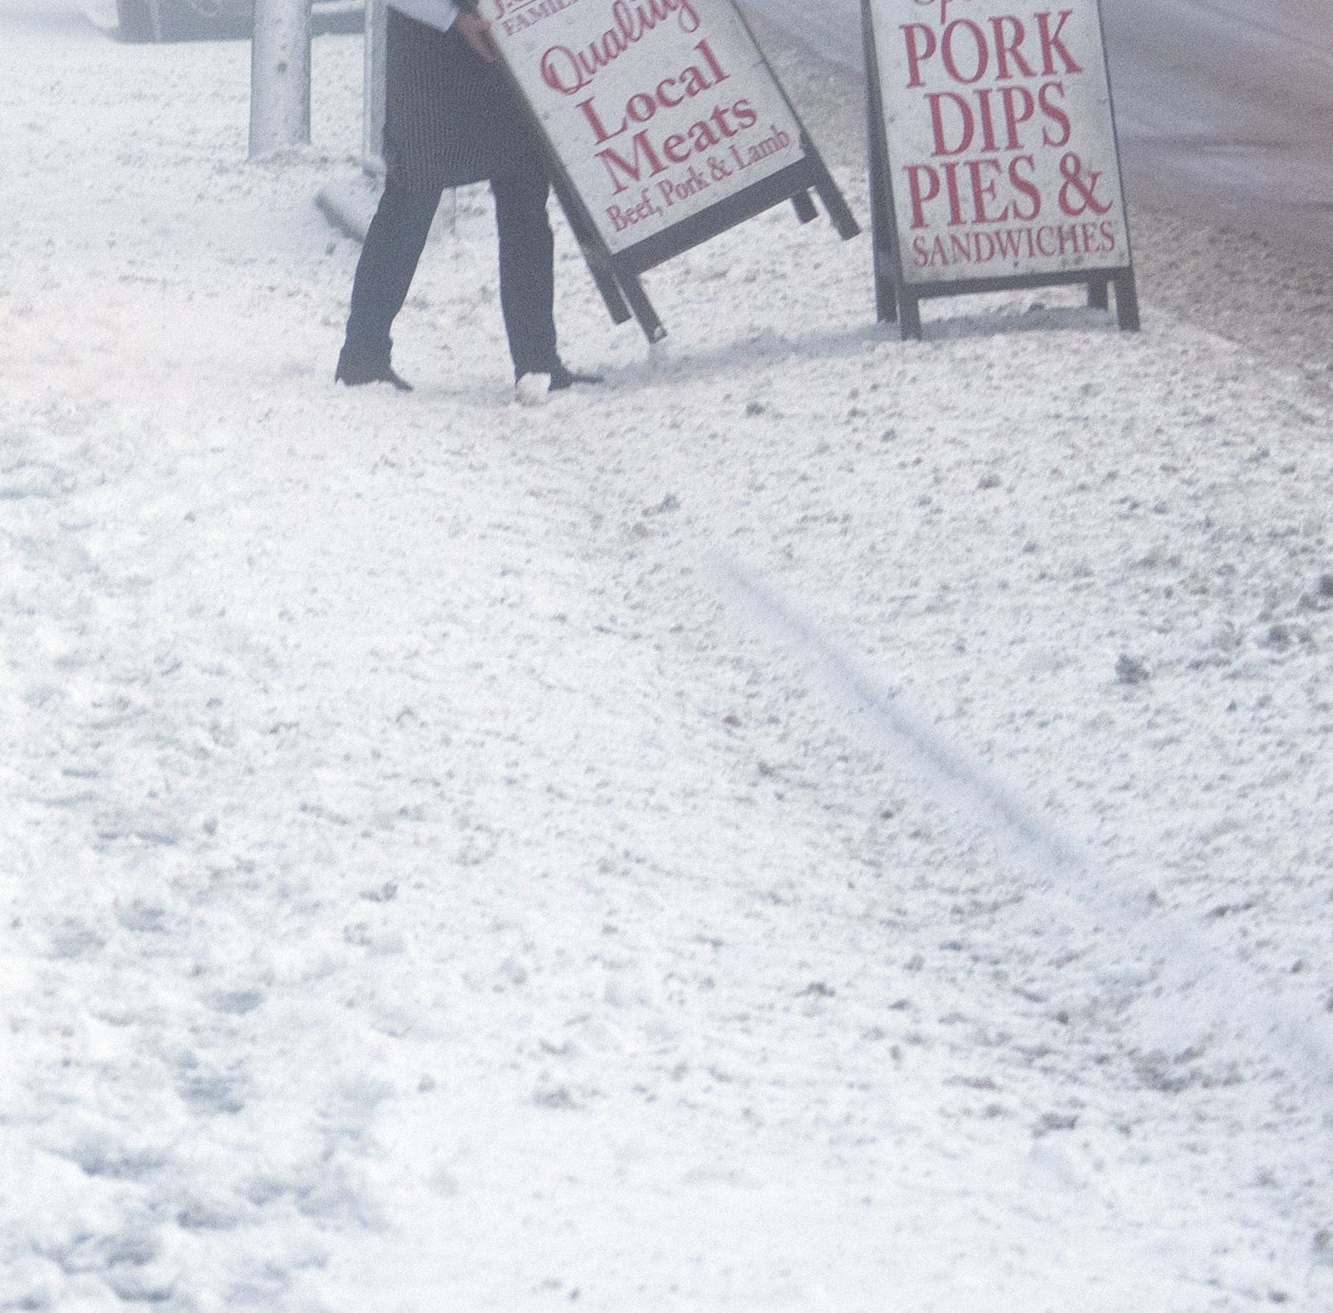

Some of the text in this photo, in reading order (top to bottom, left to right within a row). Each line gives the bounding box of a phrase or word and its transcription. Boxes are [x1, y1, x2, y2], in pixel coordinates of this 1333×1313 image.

[899, 9, 1084, 89] PORK
[575, 39, 730, 145] Local
[923, 81, 1071, 157] DIPS
[594, 98, 758, 195] Meats
[606, 125, 790, 232] Beef, Pork & Lamb
[902, 151, 1113, 230] PIES &
[912, 220, 1116, 267] SANDWICHES
